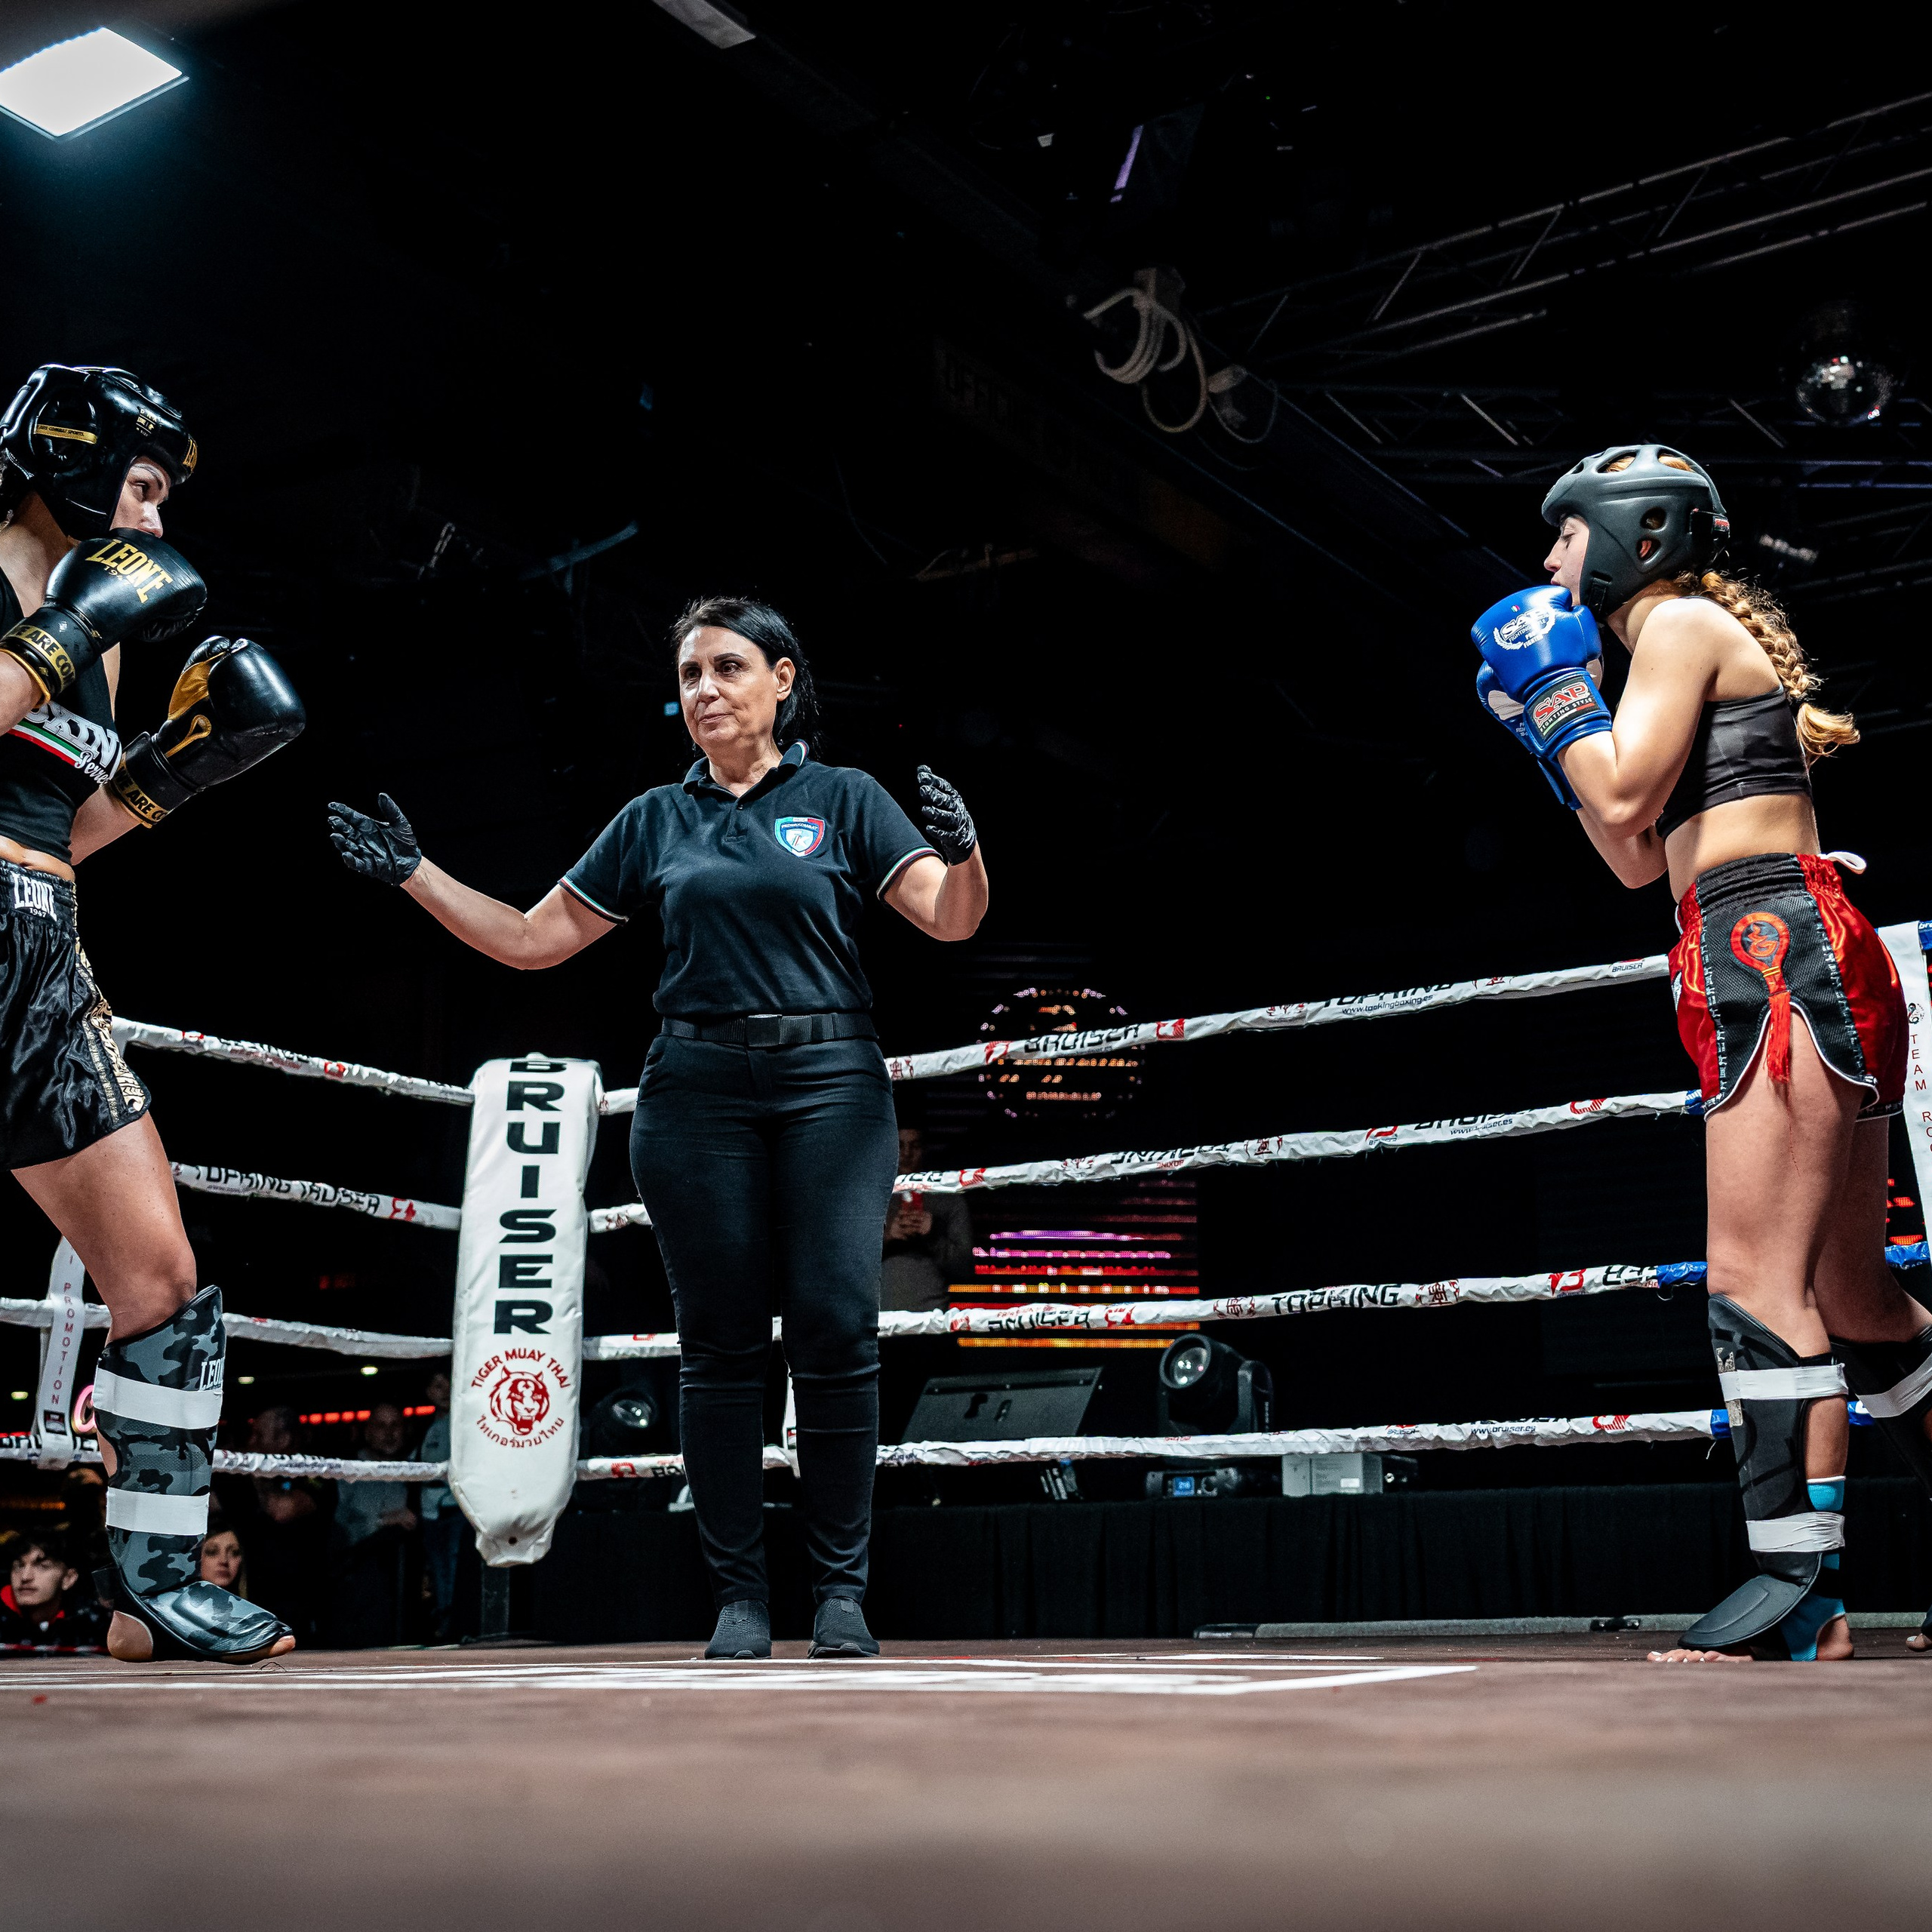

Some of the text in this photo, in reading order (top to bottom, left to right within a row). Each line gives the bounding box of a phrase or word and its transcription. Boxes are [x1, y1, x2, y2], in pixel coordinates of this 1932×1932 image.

[85, 539, 173, 604] LEONE
[25, 629, 60, 657] ARE
[1533, 681, 1591, 729] SAP
[1540, 697, 1592, 732] FIGHTING STYLE
[74, 750, 111, 786] Perre
[128, 788, 155, 814] ARE
[10, 870, 57, 922] LEONE
[30, 907, 47, 918] 1947
[1611, 962, 1643, 973] BRUISER
[1909, 1033, 1927, 1091] TEAM
[494, 1061, 568, 1335] BRUISER
[1270, 1283, 1402, 1315] TOPKING
[51, 1281, 76, 1405] PROMOTION
[471, 1348, 571, 1389] TIGER MUAY THAI
